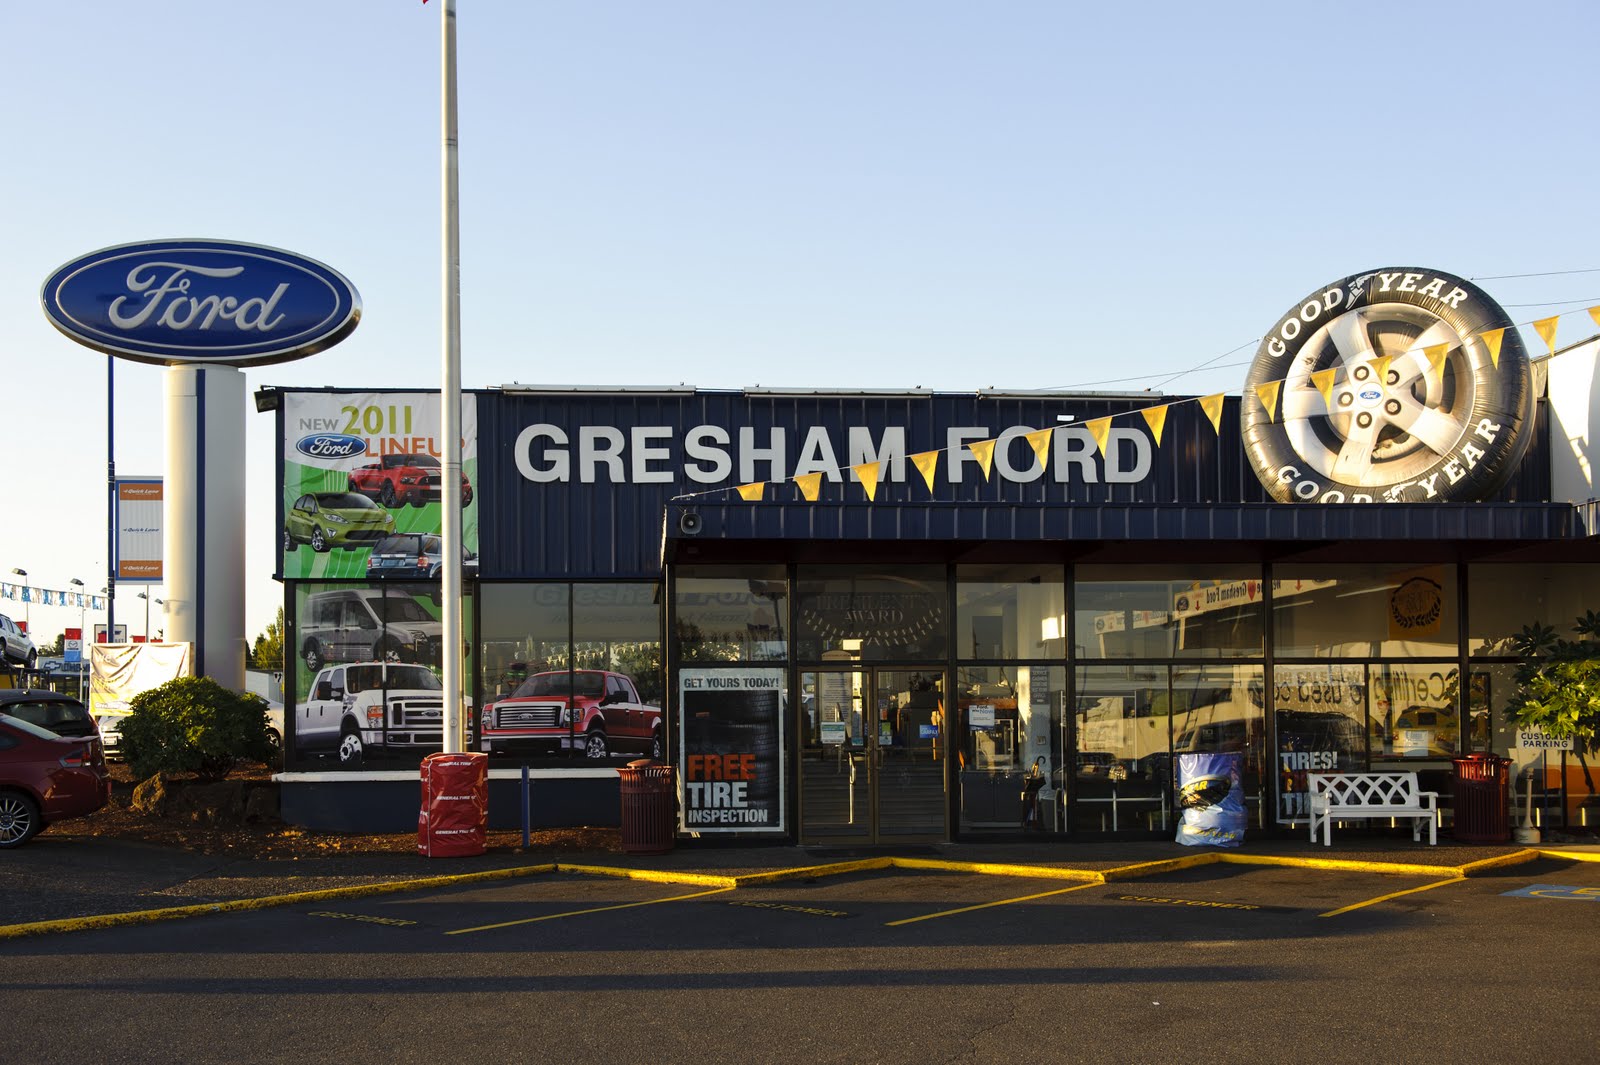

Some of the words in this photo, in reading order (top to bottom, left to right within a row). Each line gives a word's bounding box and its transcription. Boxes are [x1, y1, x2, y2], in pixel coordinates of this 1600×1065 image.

[108, 261, 290, 331] Ford
[1268, 288, 1344, 358] GOOD
[1378, 272, 1468, 309] YEAR
[300, 419, 339, 431] NEW
[341, 405, 412, 435] 2011
[310, 437, 353, 455] Ford
[365, 437, 465, 457] LINEU
[513, 423, 906, 484] GRESHAM
[946, 425, 1153, 485] FORD
[1415, 417, 1502, 499] YEAR
[844, 610, 904, 624] AWARD
[684, 678, 703, 688] GET
[707, 678, 740, 688] YOURS
[743, 677, 779, 688] TODAY!
[1523, 740, 1568, 748] PARKING
[687, 753, 757, 780] FREE
[1280, 751, 1338, 770] TIRES!
[687, 781, 748, 808] TIRE
[688, 808, 768, 823] INSPECTION
